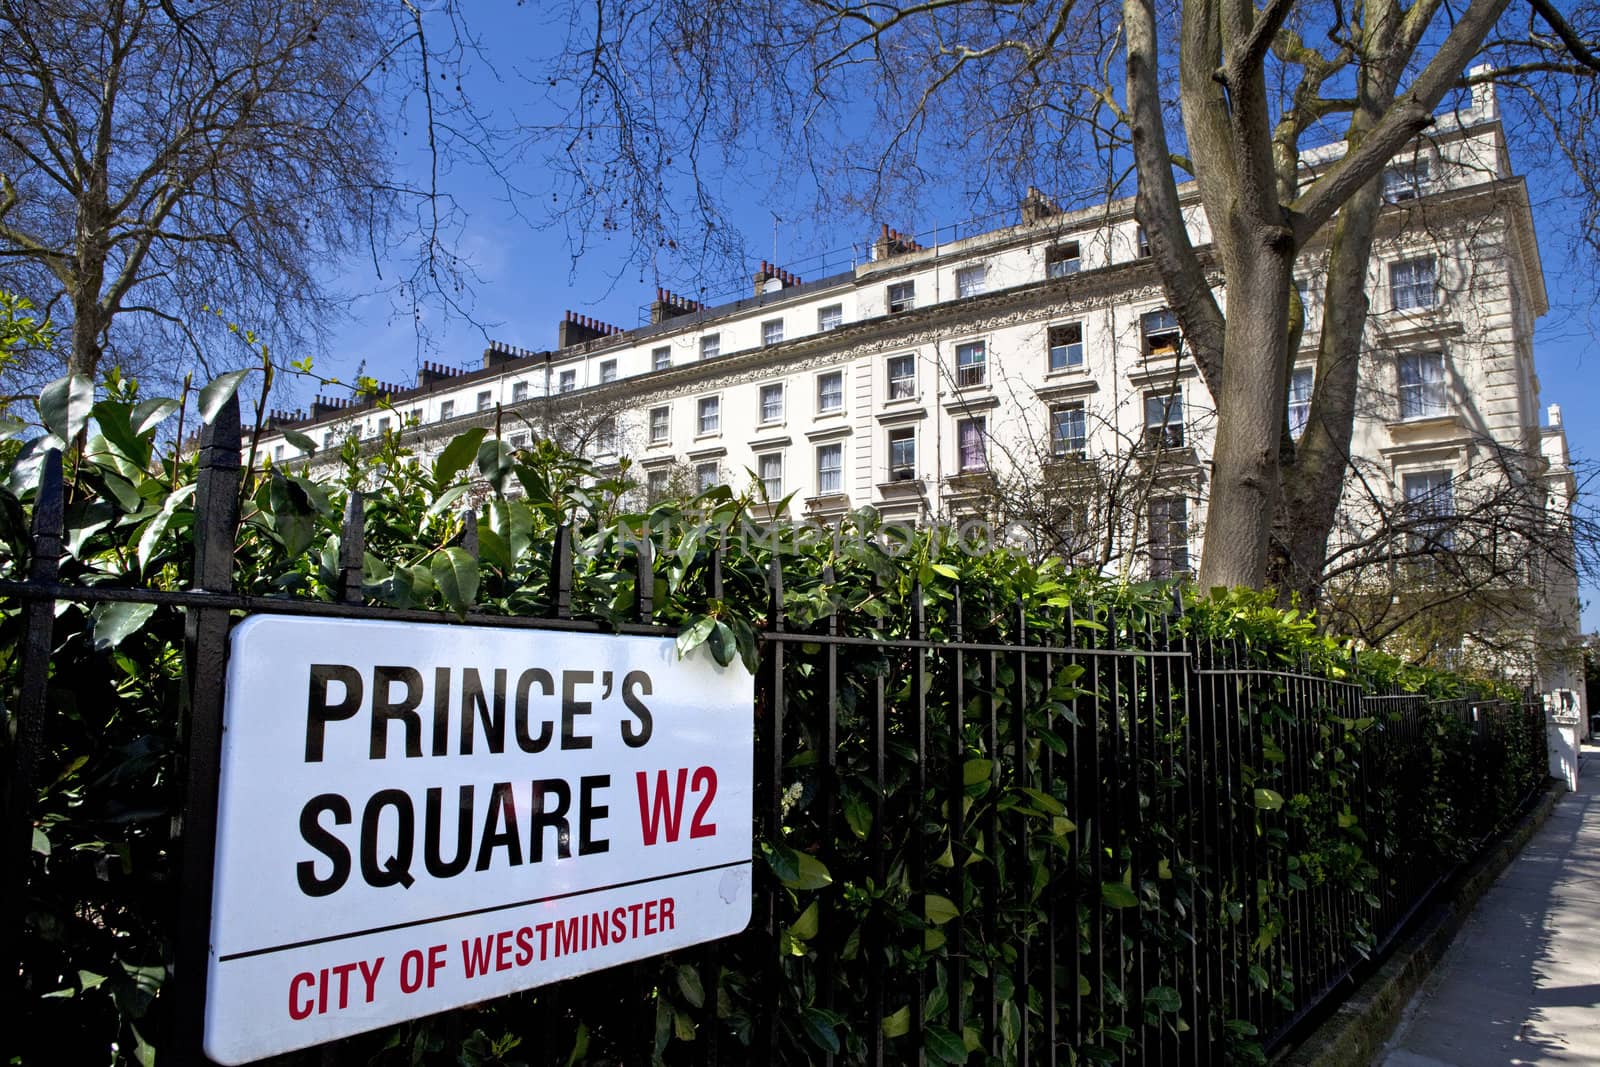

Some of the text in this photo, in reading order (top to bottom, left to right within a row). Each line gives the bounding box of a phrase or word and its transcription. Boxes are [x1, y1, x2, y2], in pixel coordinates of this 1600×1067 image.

[305, 664, 653, 763] PRINCE'S
[296, 765, 718, 898] SQUARE W2
[288, 897, 676, 1021] CITY OF WESTMINSTER
